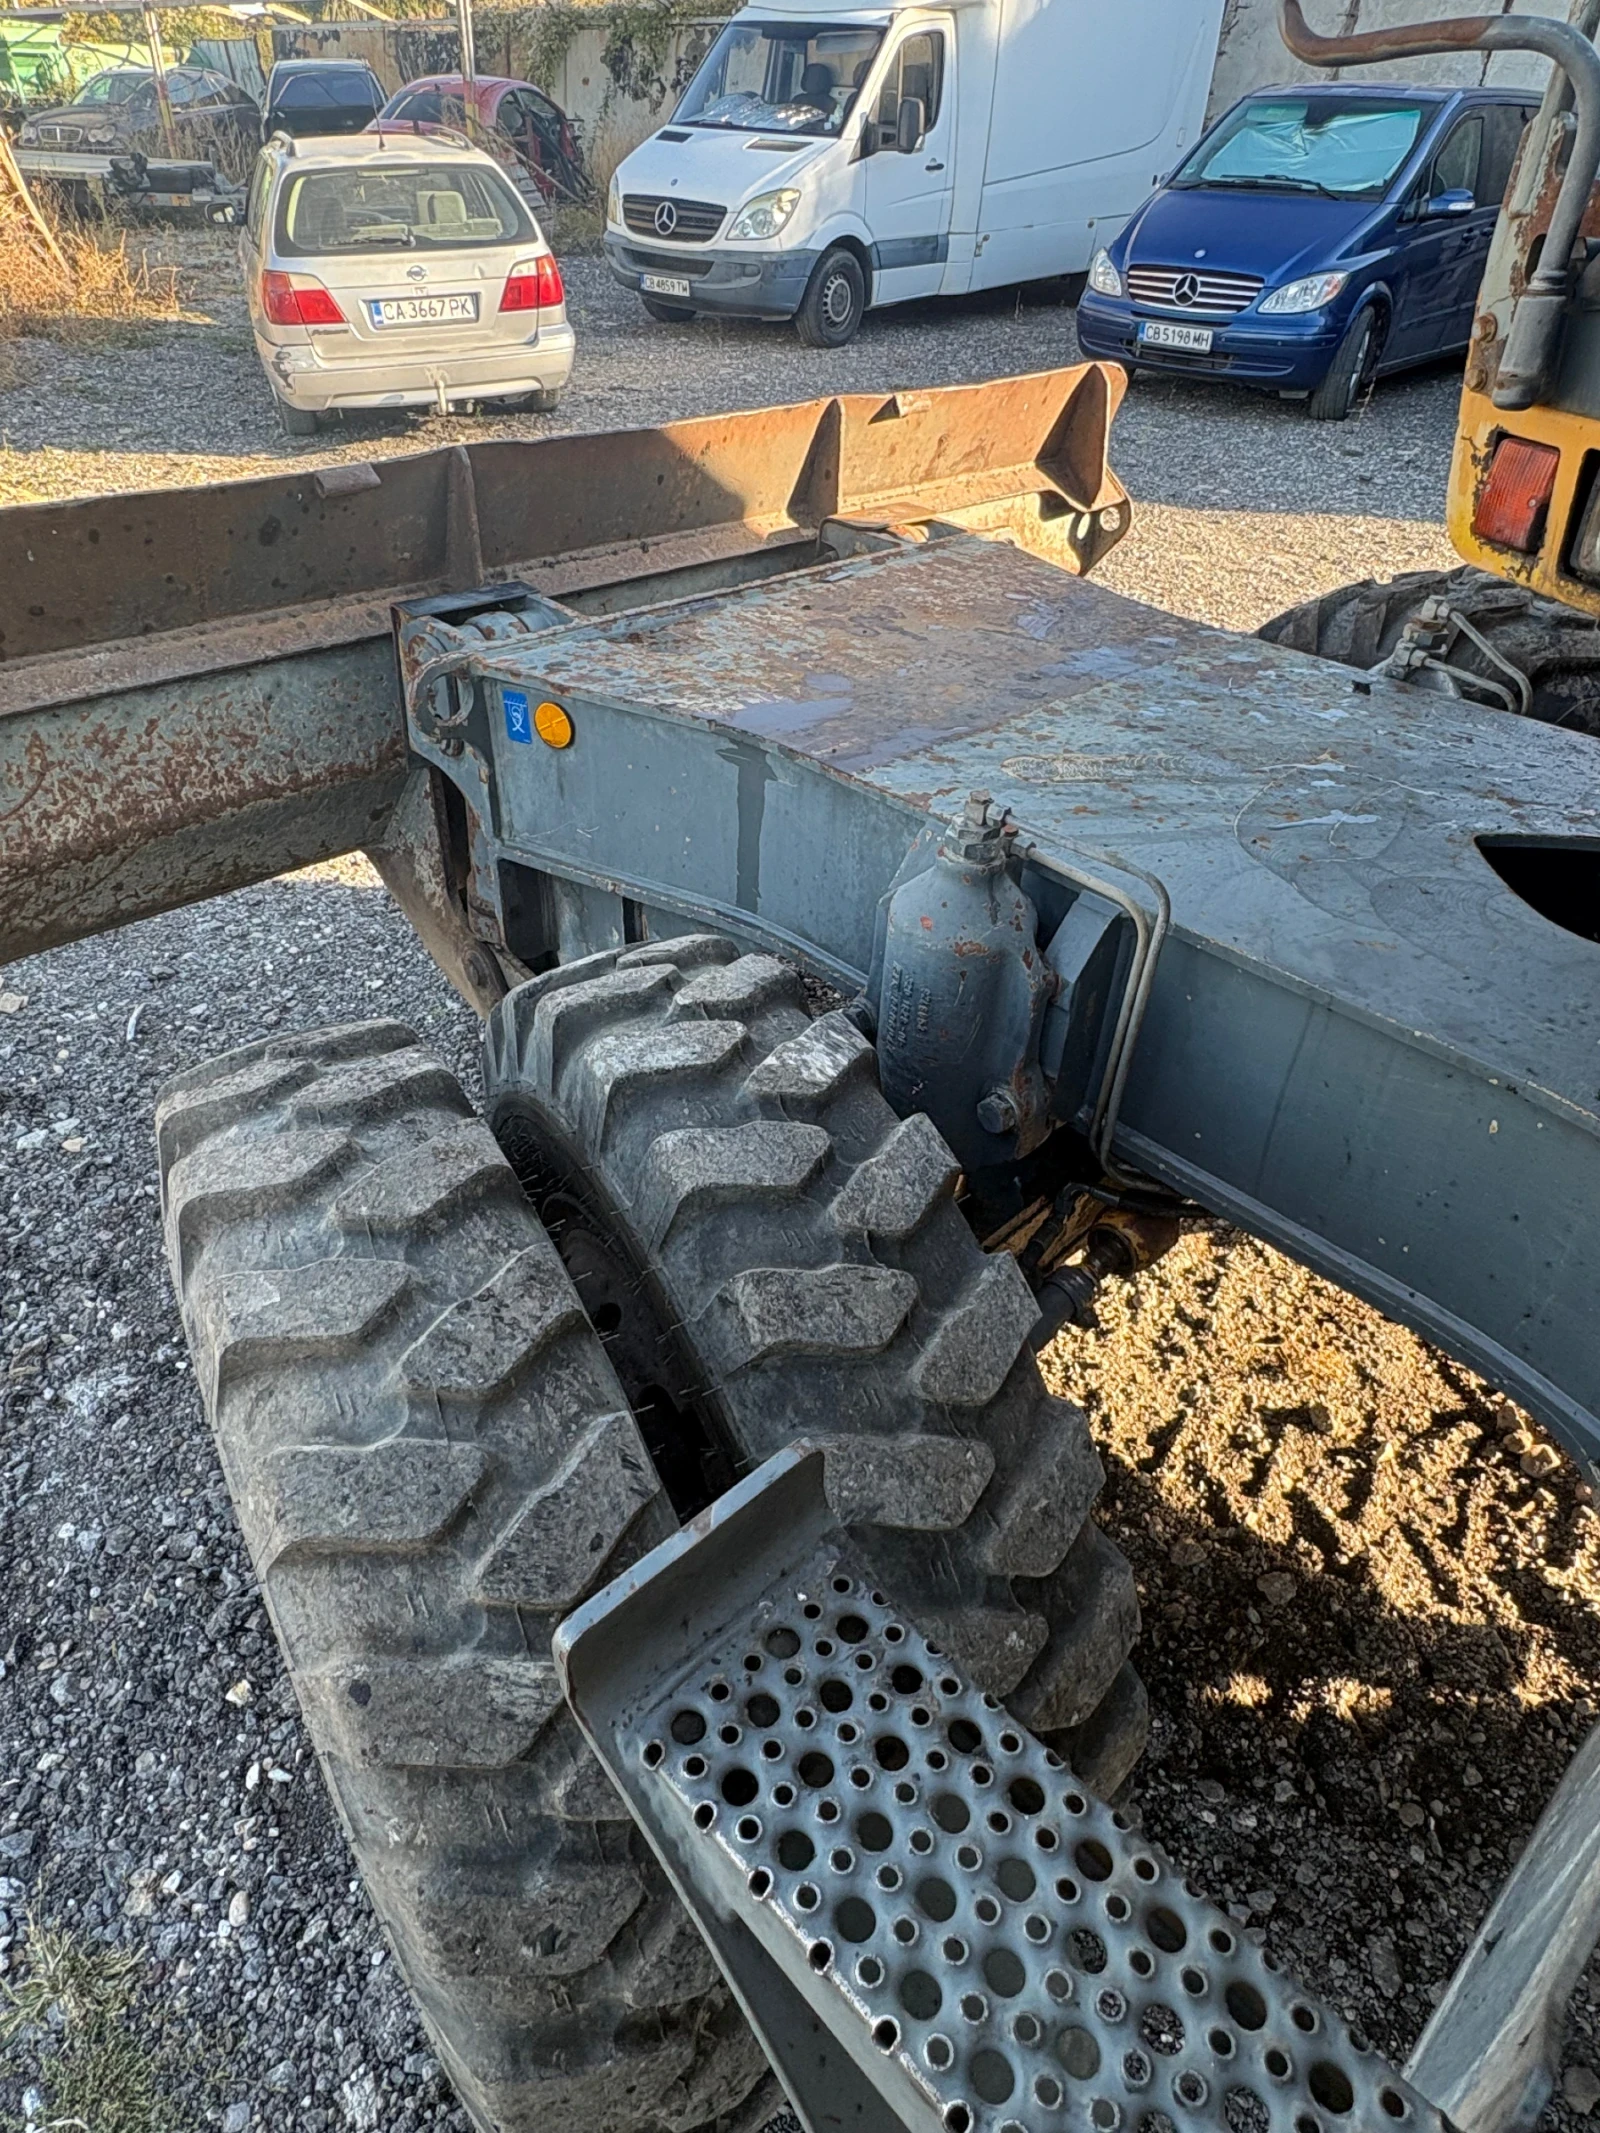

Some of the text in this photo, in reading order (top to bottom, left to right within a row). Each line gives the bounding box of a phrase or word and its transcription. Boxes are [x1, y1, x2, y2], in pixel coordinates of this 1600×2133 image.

[645, 276, 688, 294] CB 4859 TM
[383, 298, 471, 320] CA 3667 PK
[1146, 325, 1210, 347] CB 5198 MH
